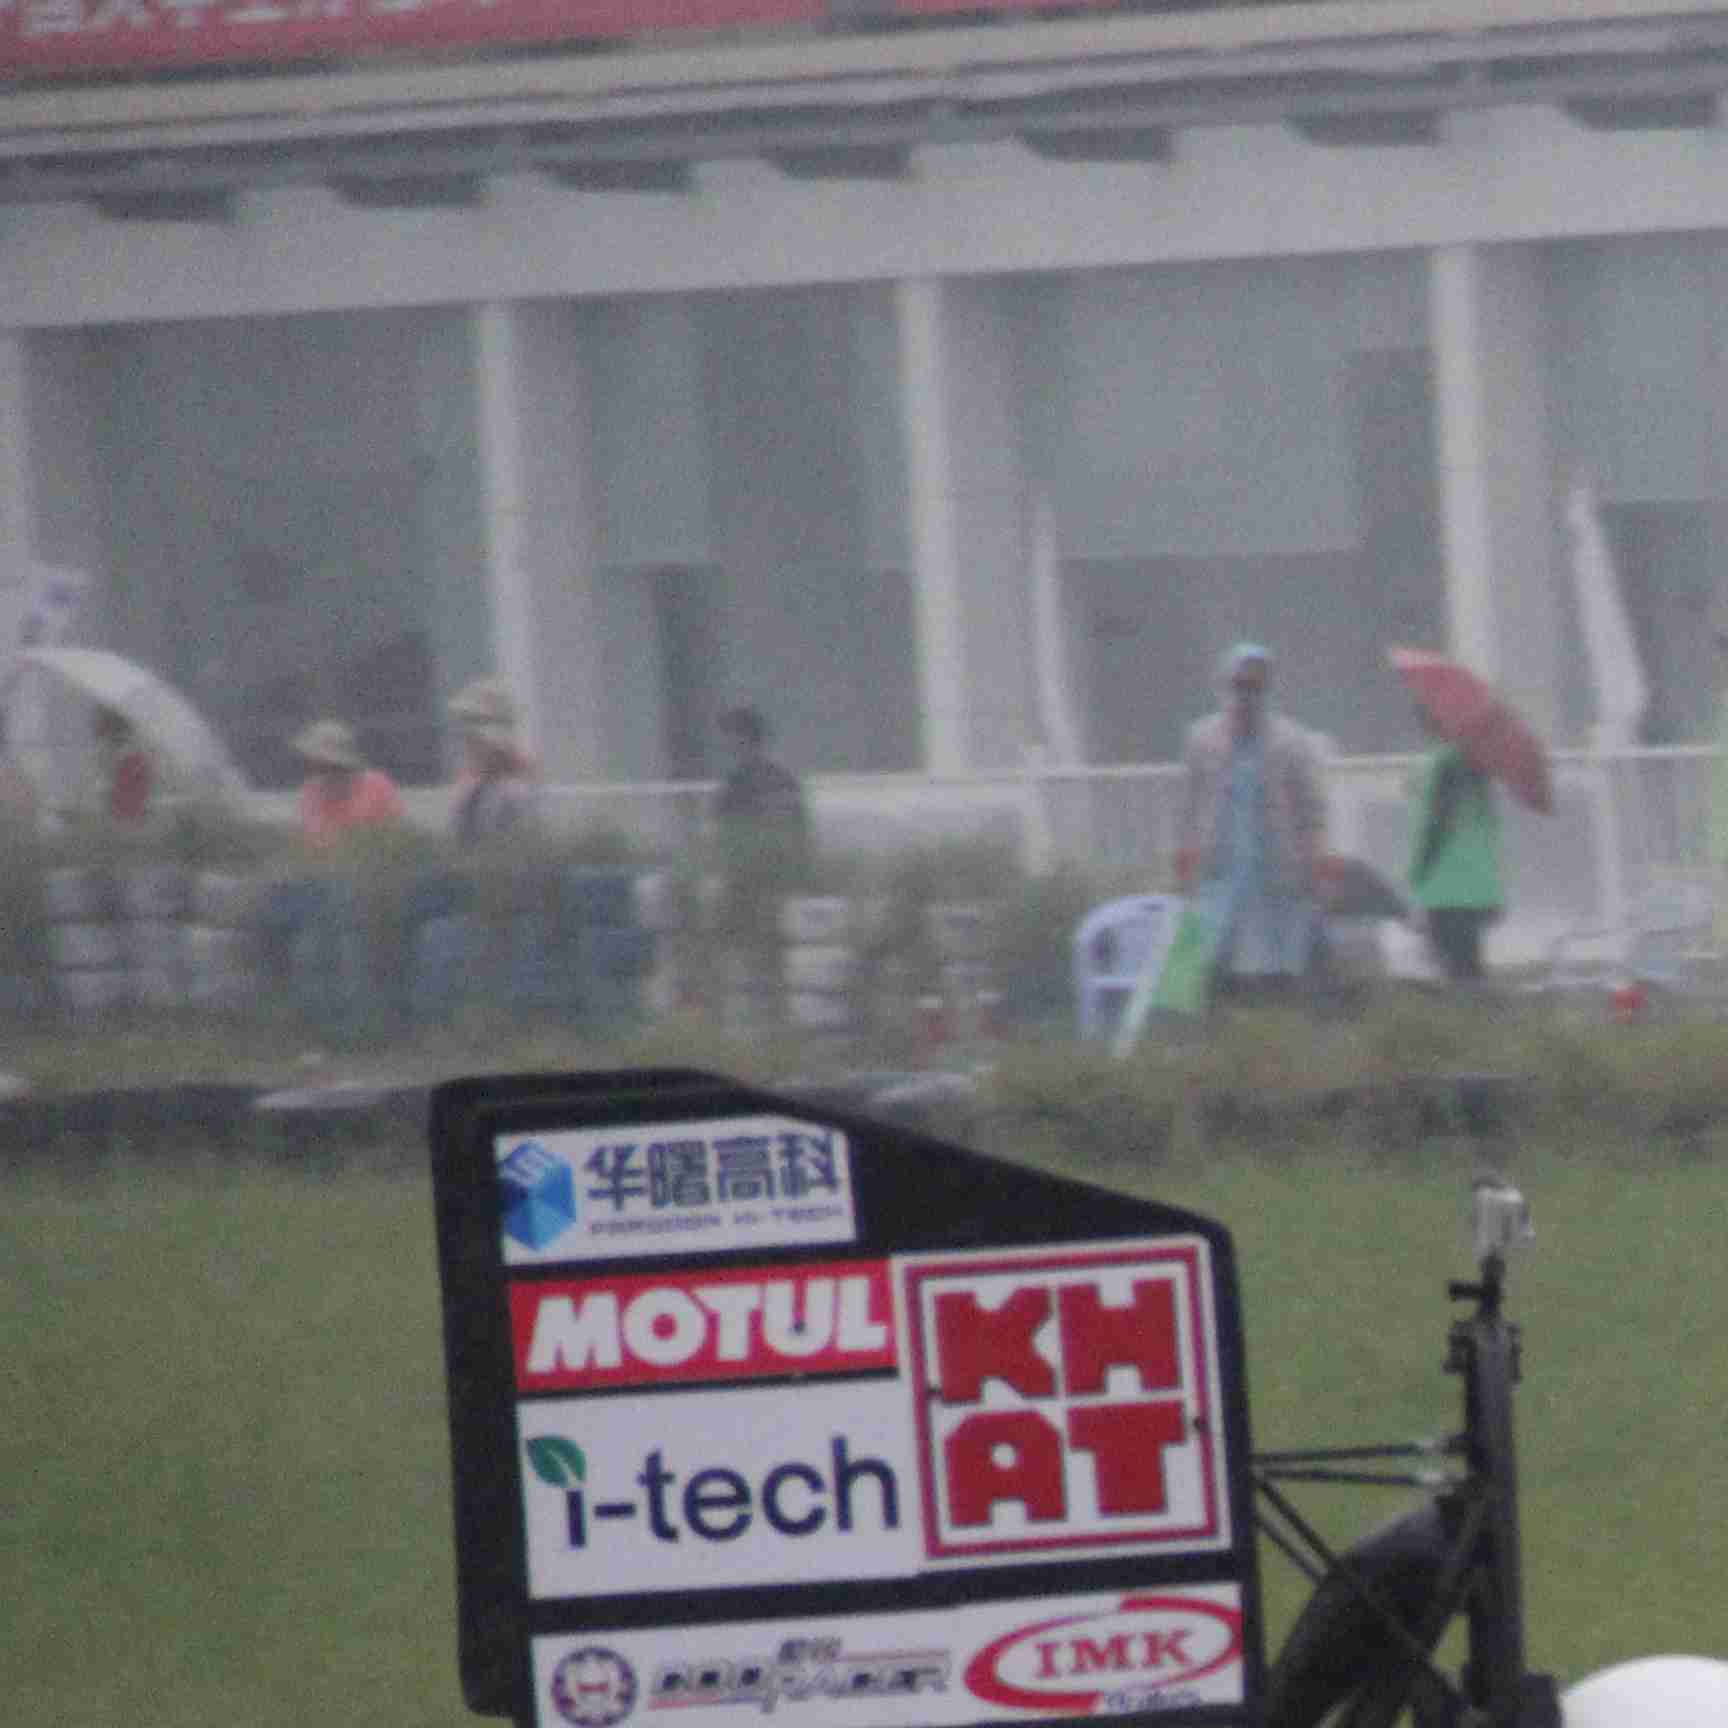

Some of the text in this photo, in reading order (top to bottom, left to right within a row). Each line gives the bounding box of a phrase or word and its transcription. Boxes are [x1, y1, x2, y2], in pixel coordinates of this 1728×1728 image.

[584, 1131, 839, 1211] 华曙高科
[527, 1274, 887, 1374] MOTUL
[563, 1435, 899, 1548] i-tech
[1033, 1628, 1193, 1678] IMK
